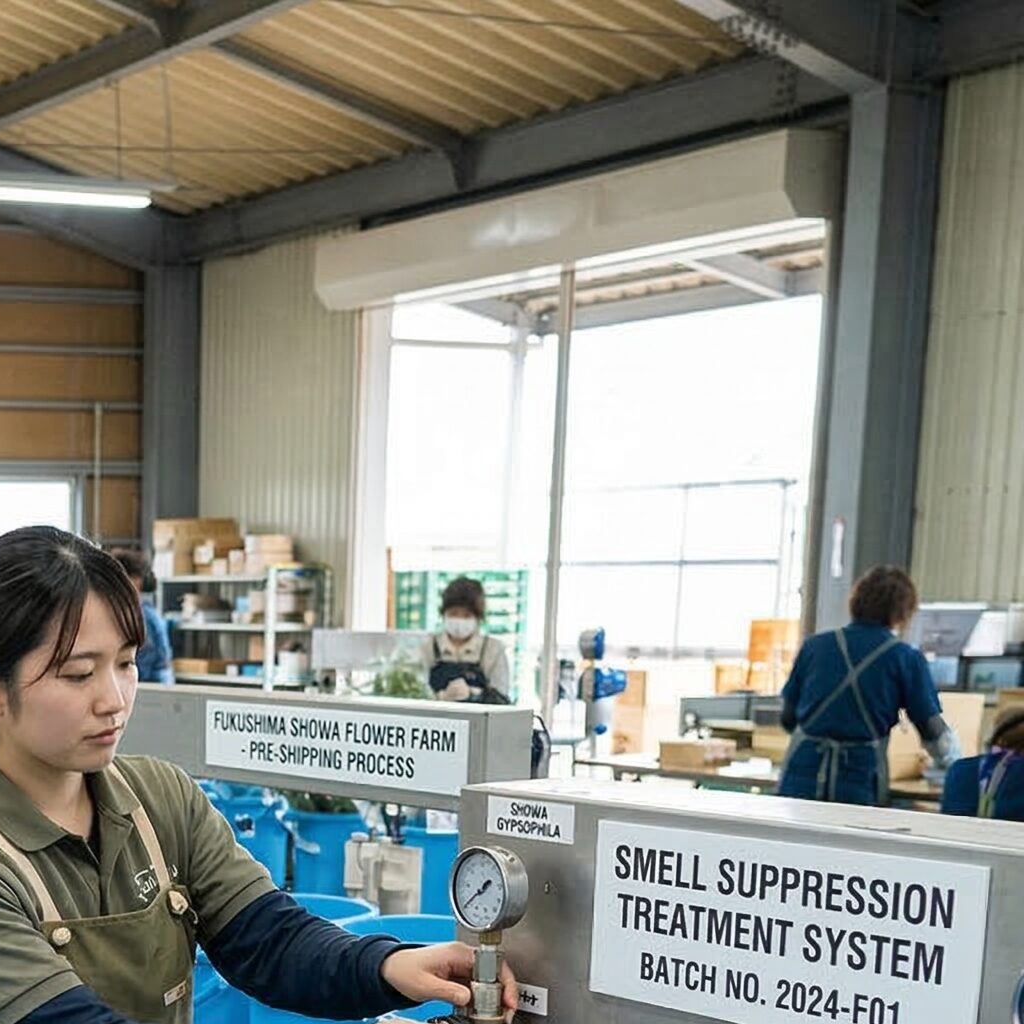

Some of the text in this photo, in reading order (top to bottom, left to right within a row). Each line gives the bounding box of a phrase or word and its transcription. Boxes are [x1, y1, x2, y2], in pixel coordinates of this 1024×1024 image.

[214, 710, 456, 753] FUKUSHIMA SHOWA FLOWER FARM
[249, 740, 343, 770] PRE-SHIPPING
[346, 751, 415, 779] PROCESS
[614, 844, 955, 929] SMELL SUPPRESSION
[617, 892, 945, 986] TREATMENT SYSTEM
[640, 951, 717, 995] BATCH
[725, 968, 766, 1006] NO.
